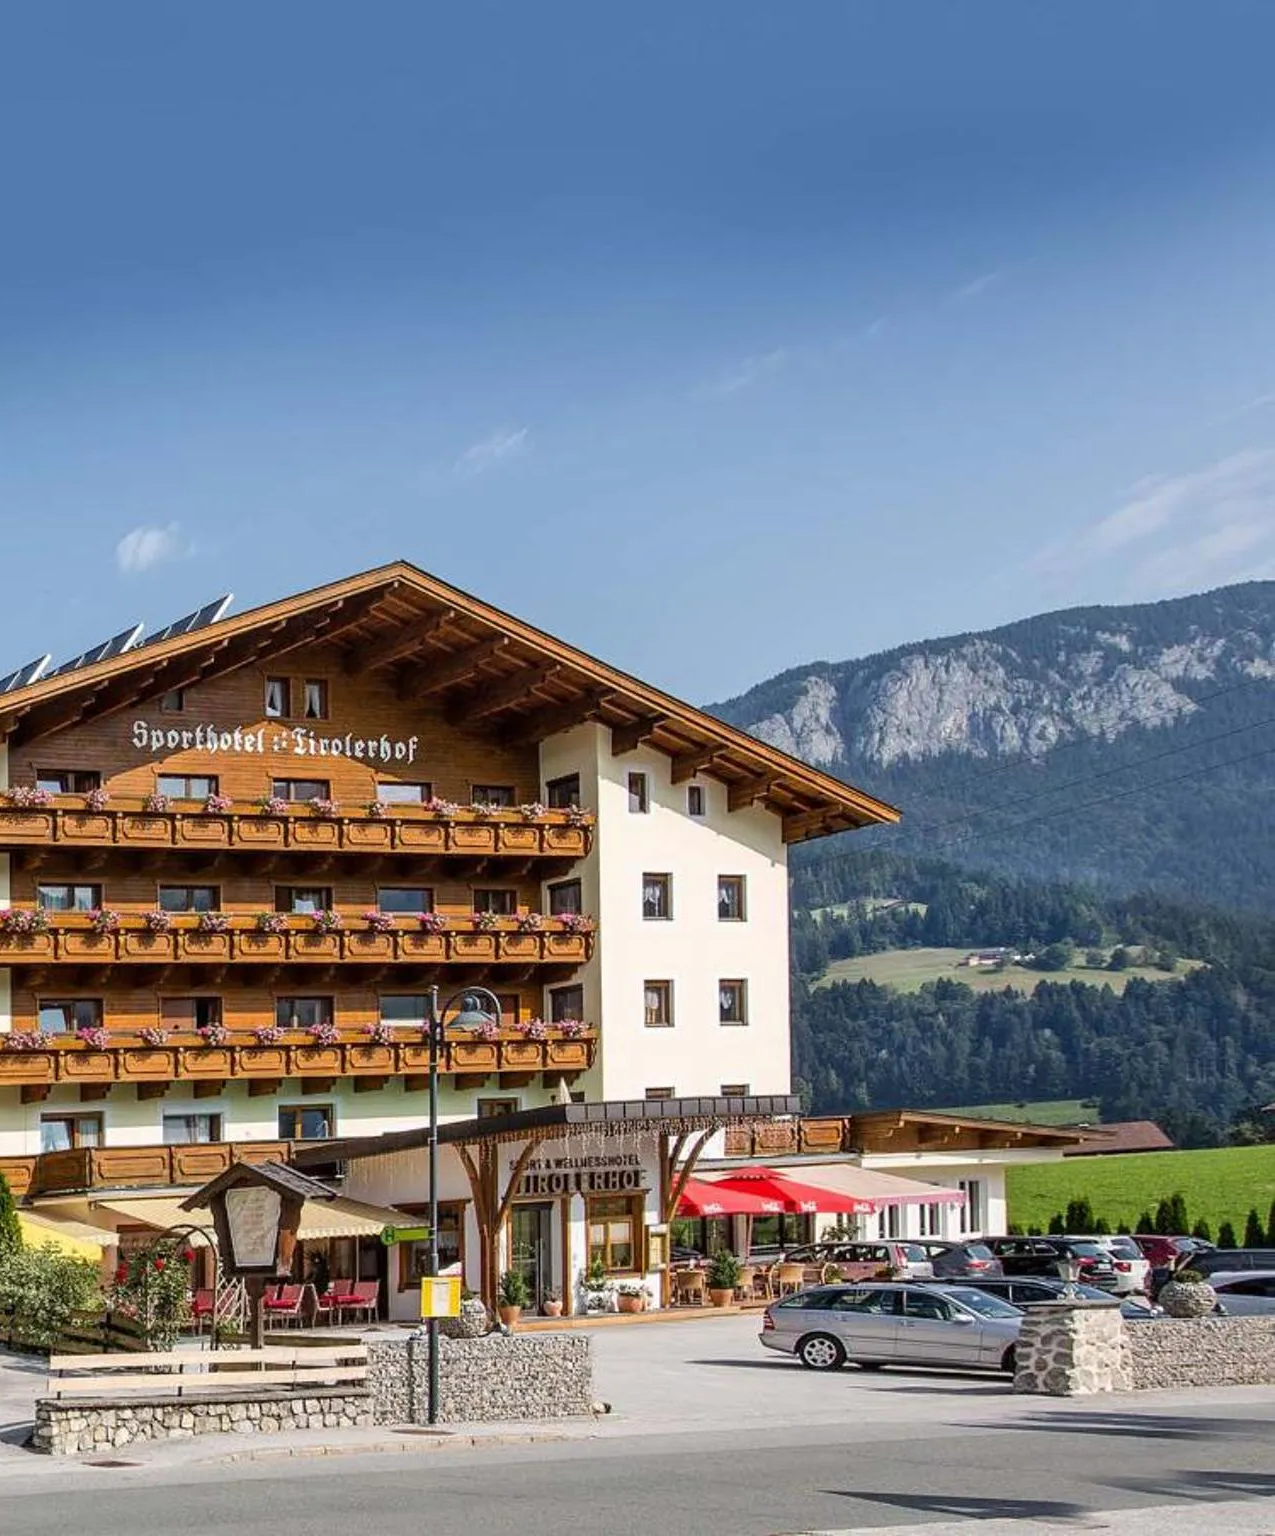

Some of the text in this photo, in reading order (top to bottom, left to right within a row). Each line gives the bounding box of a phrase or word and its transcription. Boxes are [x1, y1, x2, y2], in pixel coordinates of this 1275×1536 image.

[132, 720, 419, 765] Sporthotel Tirolerhof
[509, 1158, 542, 1171] SORT
[554, 1153, 641, 1169] WELLNESSHOTEL
